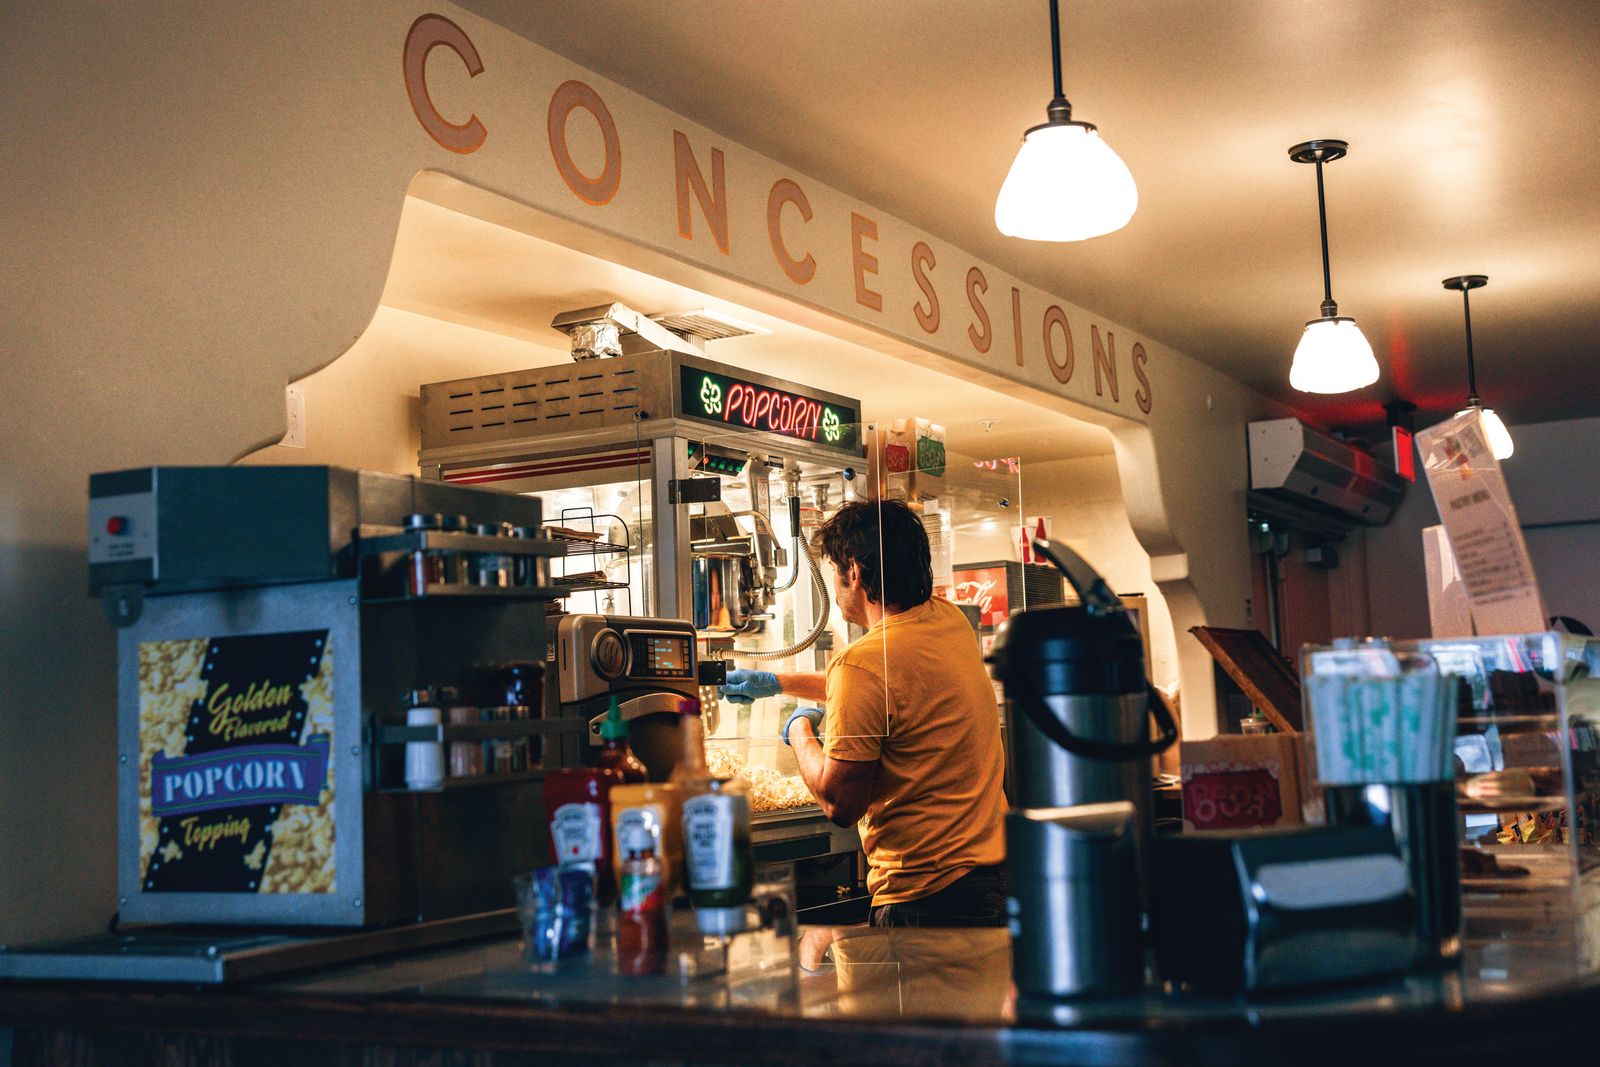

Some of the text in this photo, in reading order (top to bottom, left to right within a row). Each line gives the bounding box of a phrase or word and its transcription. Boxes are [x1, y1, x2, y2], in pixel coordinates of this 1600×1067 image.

[403, 12, 1152, 414] CONCESSIONS
[723, 383, 823, 440] POPCORN
[207, 679, 293, 735] Golden
[224, 711, 292, 742] Flavored
[163, 760, 308, 802] POPCORN
[180, 815, 251, 851] Topping
